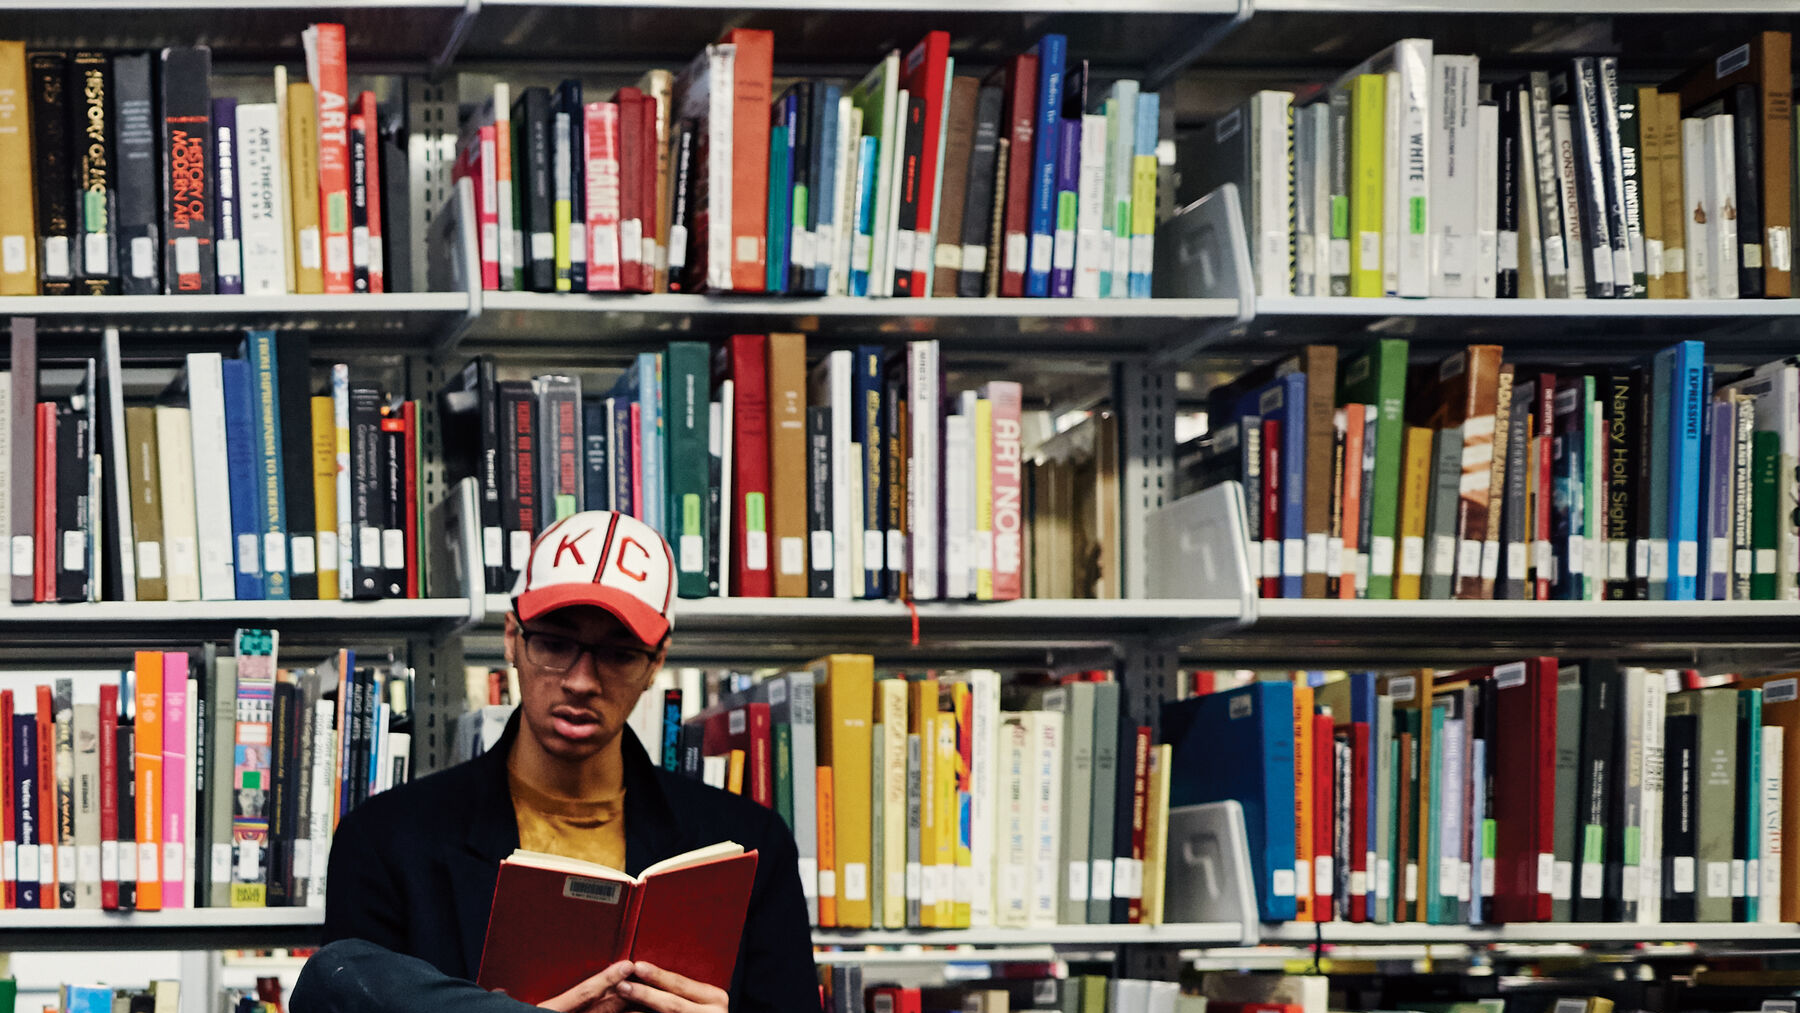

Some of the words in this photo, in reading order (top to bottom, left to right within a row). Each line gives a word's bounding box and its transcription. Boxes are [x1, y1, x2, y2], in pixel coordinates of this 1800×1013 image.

[85, 70, 105, 141] HISTORY
[321, 90, 347, 146] ART
[88, 143, 107, 166] OF
[259, 127, 272, 153] ART
[354, 142, 365, 158] Art
[1409, 132, 1424, 181] WHITE
[1621, 146, 1635, 177] AFTER
[172, 130, 190, 201] MODERN
[188, 137, 205, 197] HISTORY
[189, 200, 205, 222] OF
[260, 165, 273, 220] THEORY
[588, 159, 620, 221] GAME
[1562, 139, 1580, 241] CONSTRUCTIVE
[1625, 178, 1641, 239] CONSTRUCTI
[174, 202, 191, 230] ART
[257, 337, 270, 370] FROM
[259, 371, 276, 456] IMPRESSIONISM
[1612, 385, 1629, 443] Nancy
[265, 458, 276, 474] TO
[995, 418, 1021, 480] ART
[1612, 448, 1628, 485] Holt
[1737, 443, 1747, 465] AND
[266, 475, 279, 522] MODERN
[995, 485, 1021, 545] NO
[1610, 491, 1627, 538] Sight
[1737, 467, 1747, 546] PARTICIPATION
[552, 527, 594, 568] K
[615, 536, 650, 583] C
[353, 683, 363, 713] AUDIO
[365, 682, 374, 713] AUDIO
[352, 716, 362, 741] ARTS
